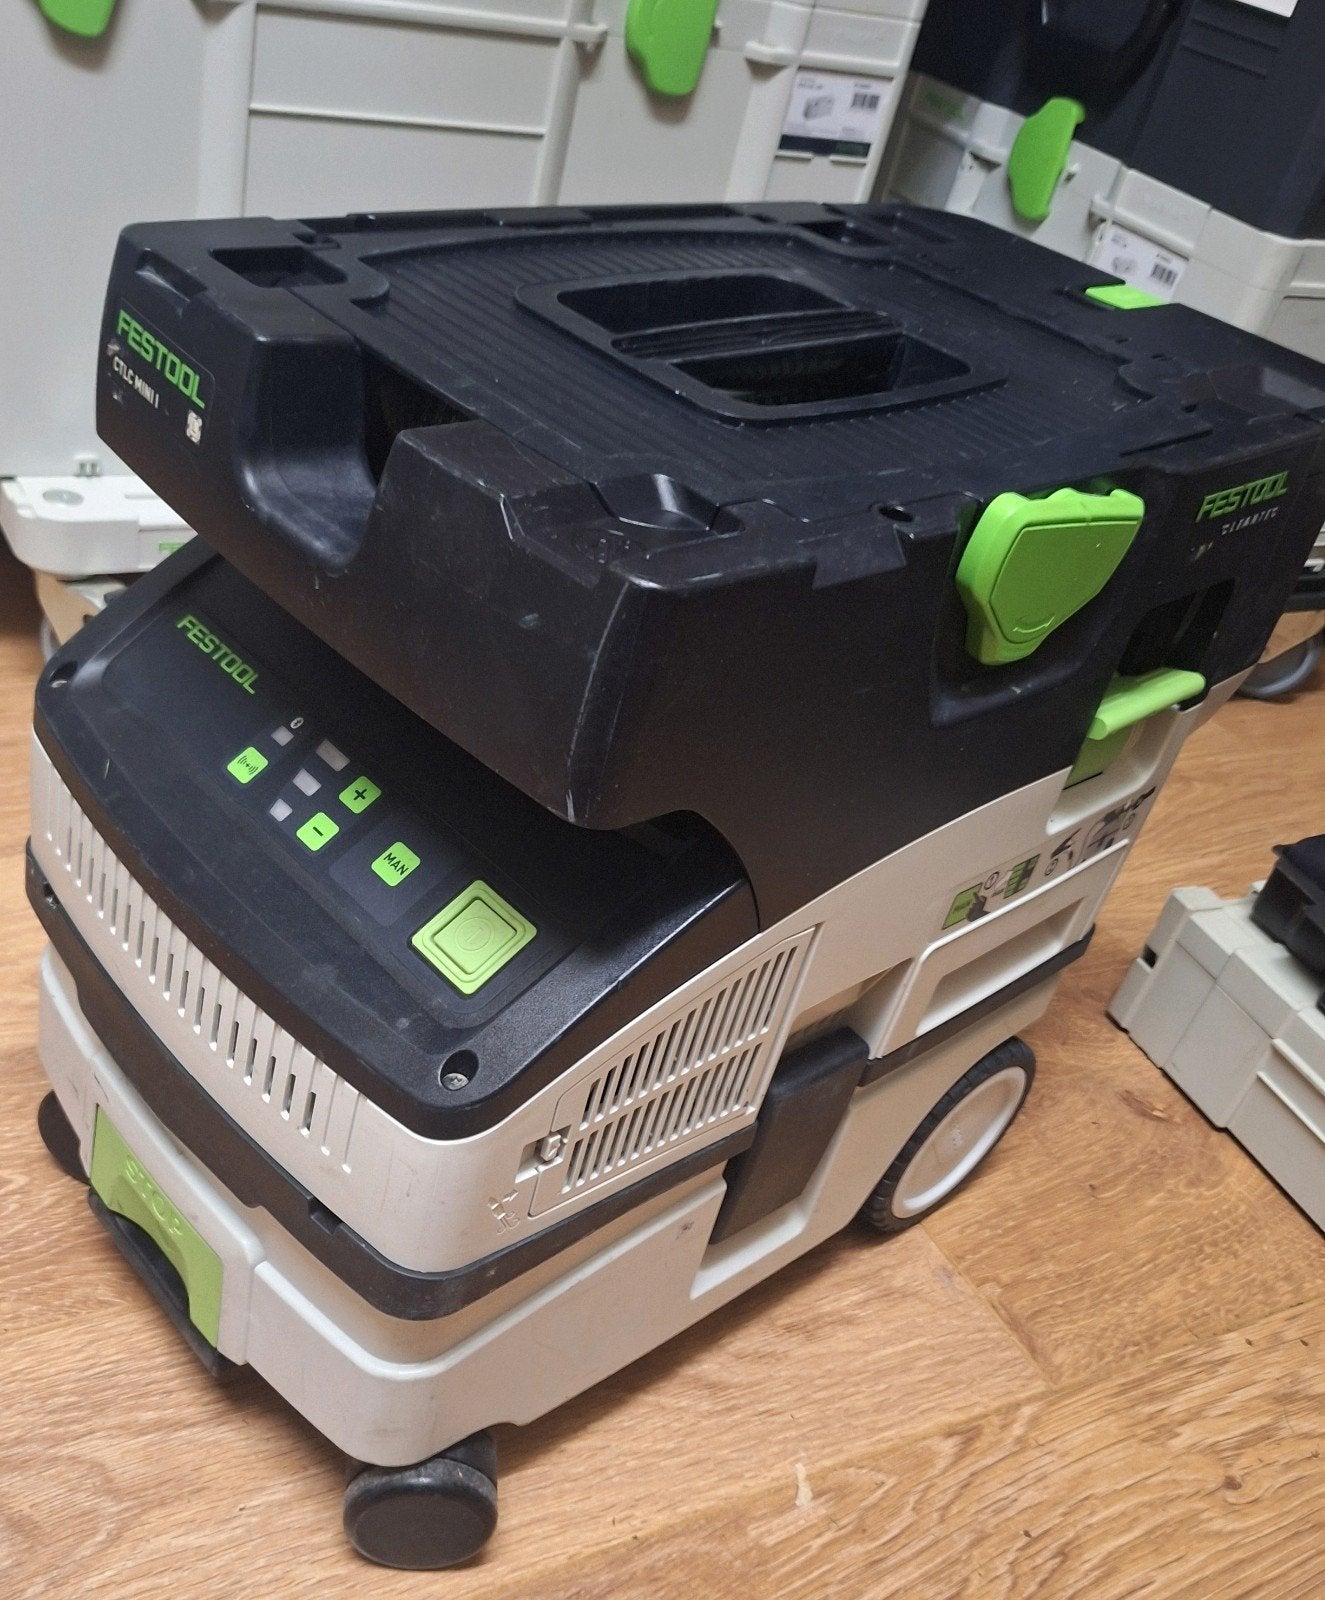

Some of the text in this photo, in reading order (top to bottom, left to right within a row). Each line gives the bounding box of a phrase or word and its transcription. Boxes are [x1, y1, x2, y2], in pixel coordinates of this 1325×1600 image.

[113, 356, 135, 385] CTLC
[117, 309, 206, 409] FESTOOL
[1195, 470, 1288, 523] FESTOOL
[177, 615, 259, 695] FESTOOL
[383, 852, 410, 876] MAN
